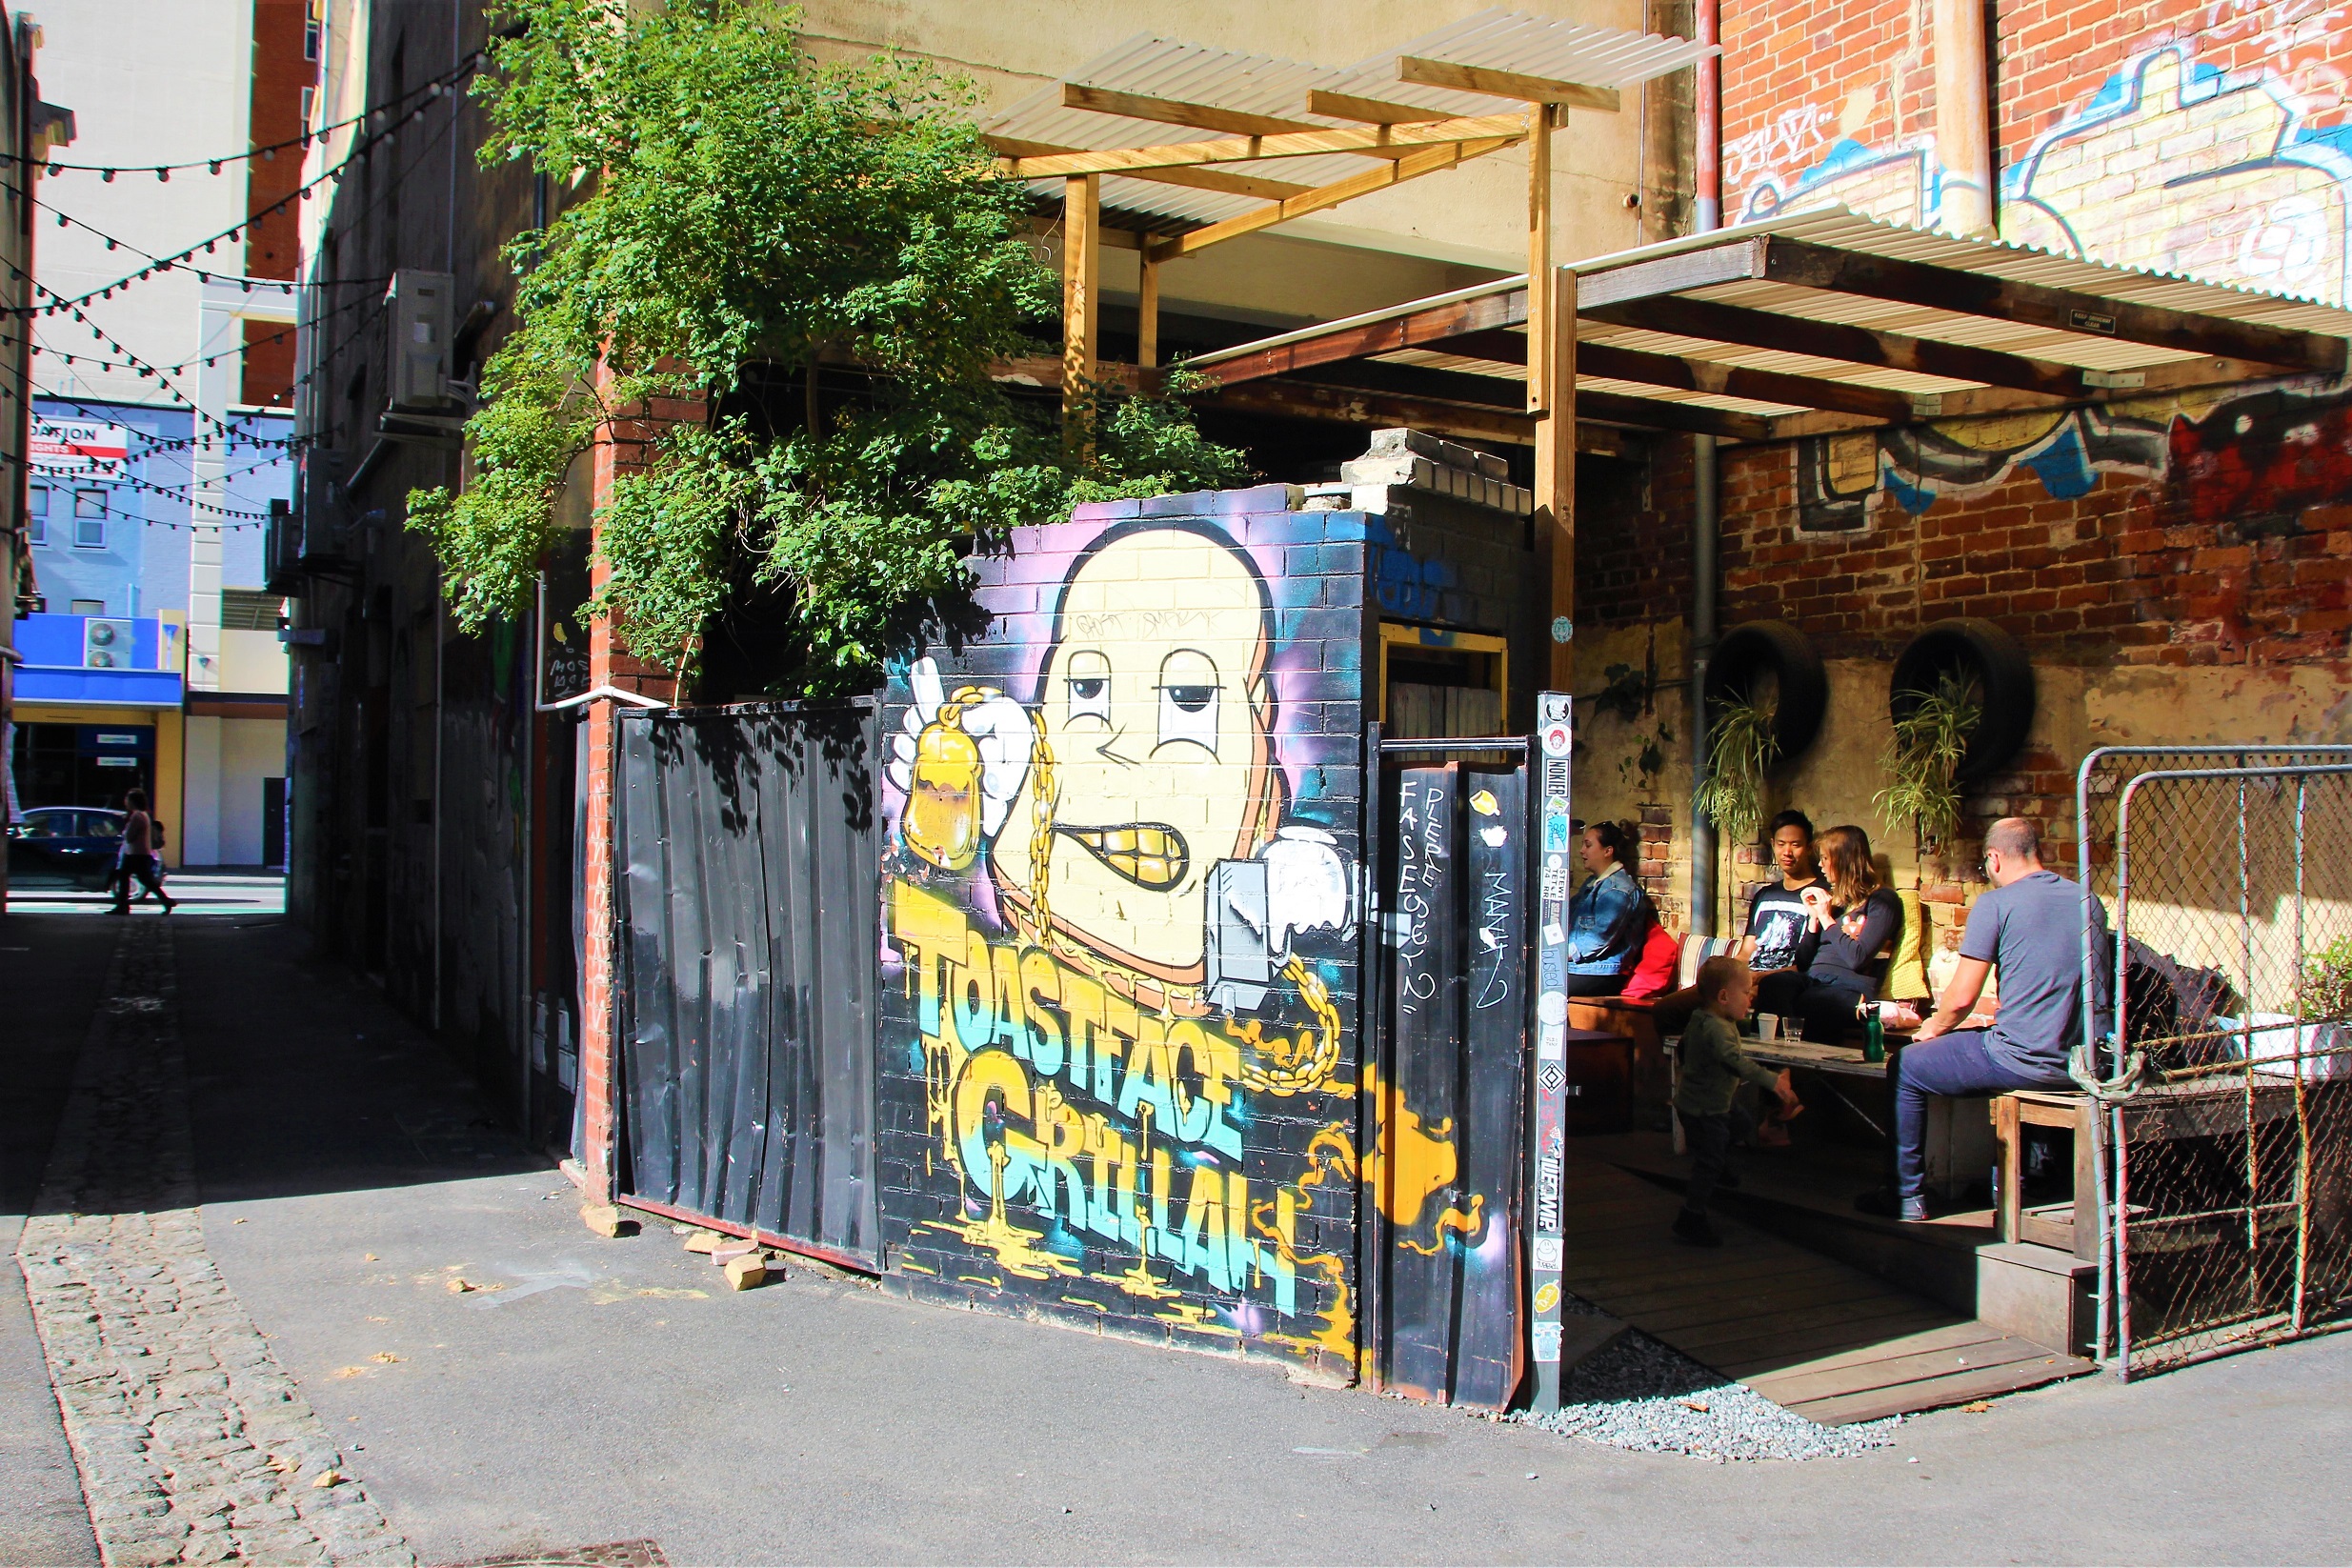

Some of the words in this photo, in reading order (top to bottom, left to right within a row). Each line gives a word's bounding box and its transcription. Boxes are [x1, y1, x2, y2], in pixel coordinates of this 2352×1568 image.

[1547, 760, 1567, 794] NOKIER
[895, 880, 1242, 1161] TOASTFACE
[1541, 951, 1561, 988] busted
[956, 1050, 1297, 1318] GRILLAH
